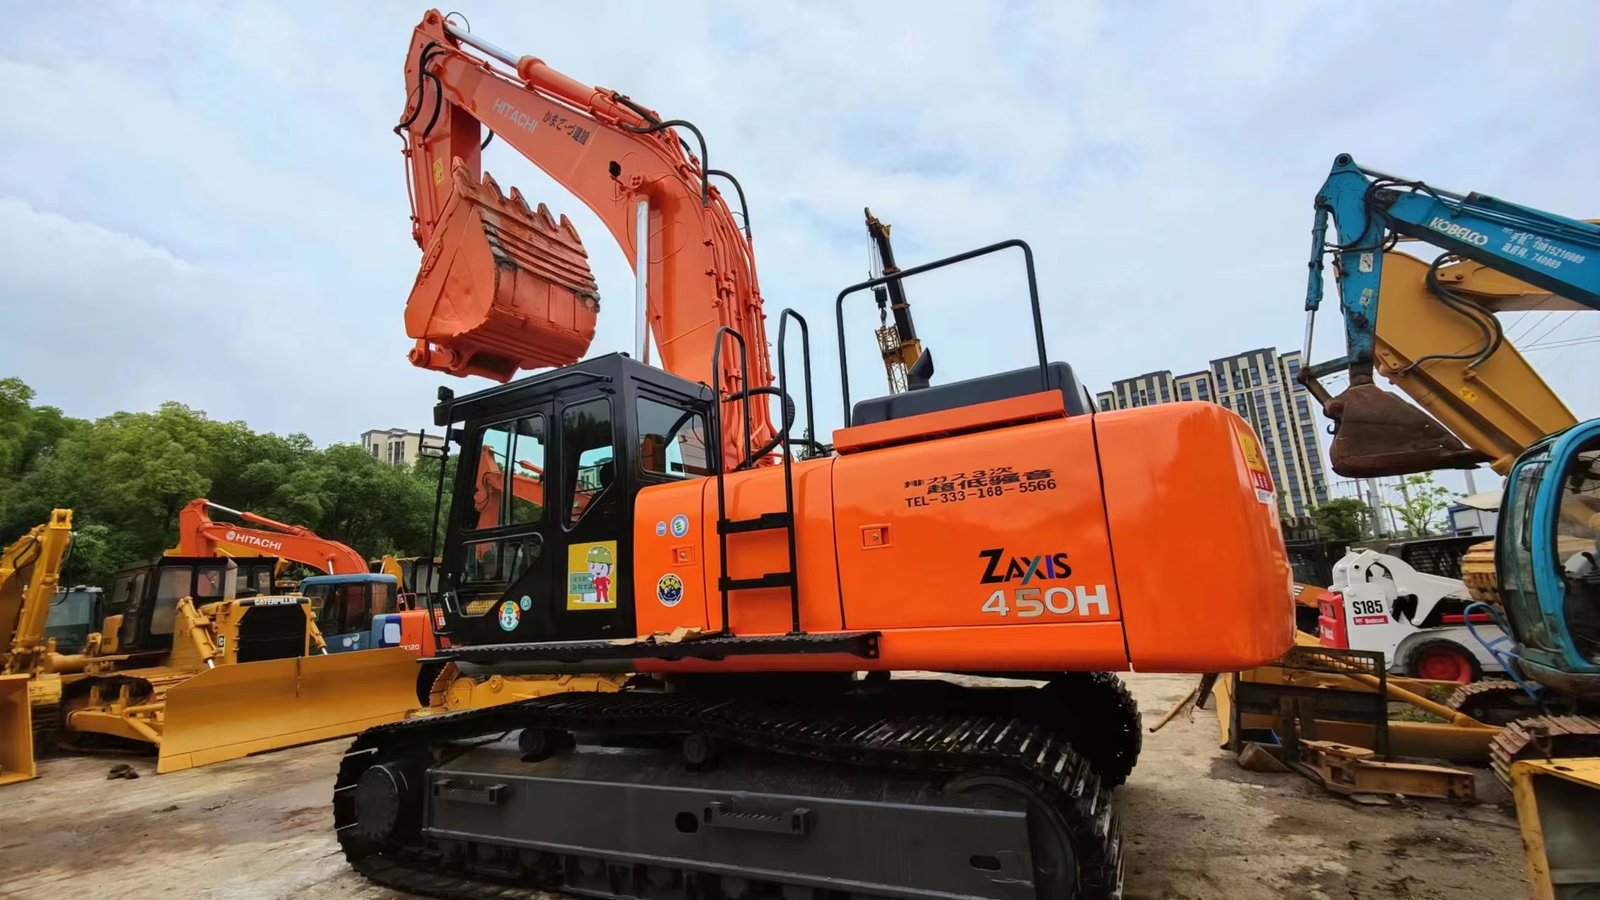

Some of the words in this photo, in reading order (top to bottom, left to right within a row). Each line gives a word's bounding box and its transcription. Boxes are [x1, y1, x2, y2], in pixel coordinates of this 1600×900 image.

[493, 98, 538, 134] HITACHI
[1429, 217, 1488, 245] KOBELCO
[235, 533, 282, 551] HITACHI
[254, 597, 297, 606] CATERPILLAR
[981, 584, 1110, 617] 450H
[1352, 600, 1383, 614] S185
